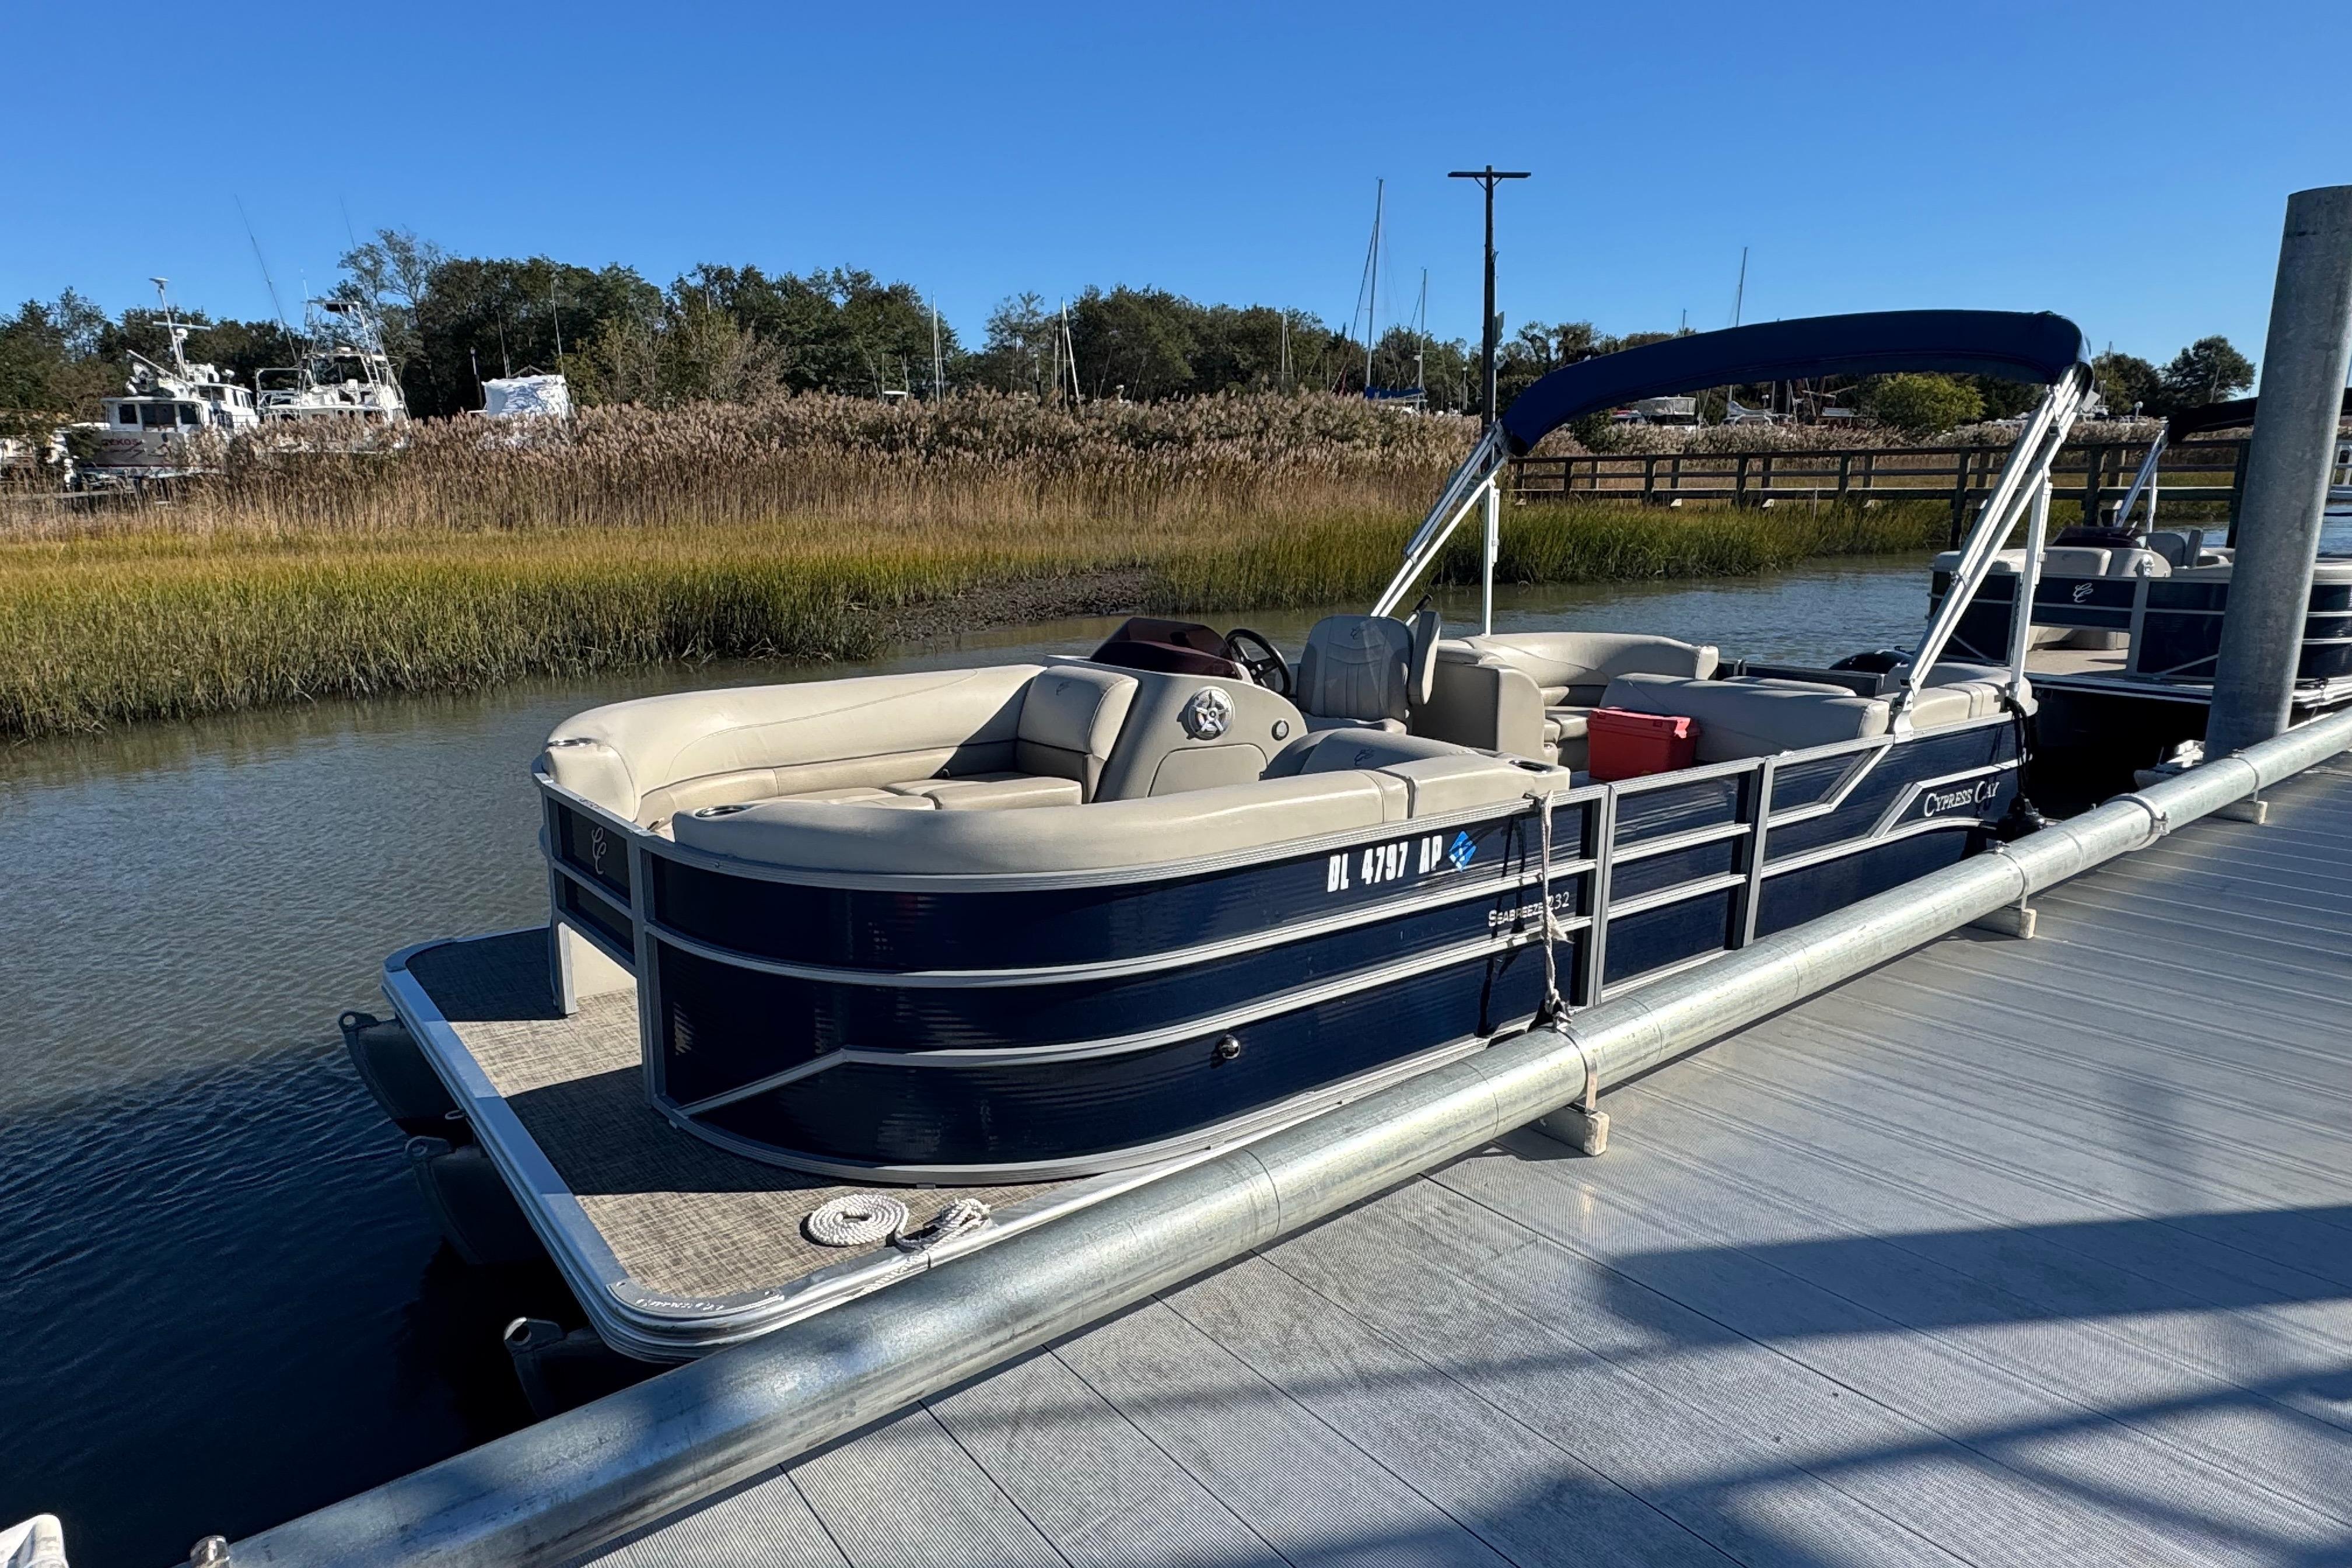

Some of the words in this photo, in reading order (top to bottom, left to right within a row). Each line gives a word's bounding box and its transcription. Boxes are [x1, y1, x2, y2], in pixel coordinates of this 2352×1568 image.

[1924, 789, 1973, 817] CYPRESS
[1327, 853, 1349, 892] DL
[1362, 841, 1409, 884] 4797
[1419, 835, 1443, 874] AP
